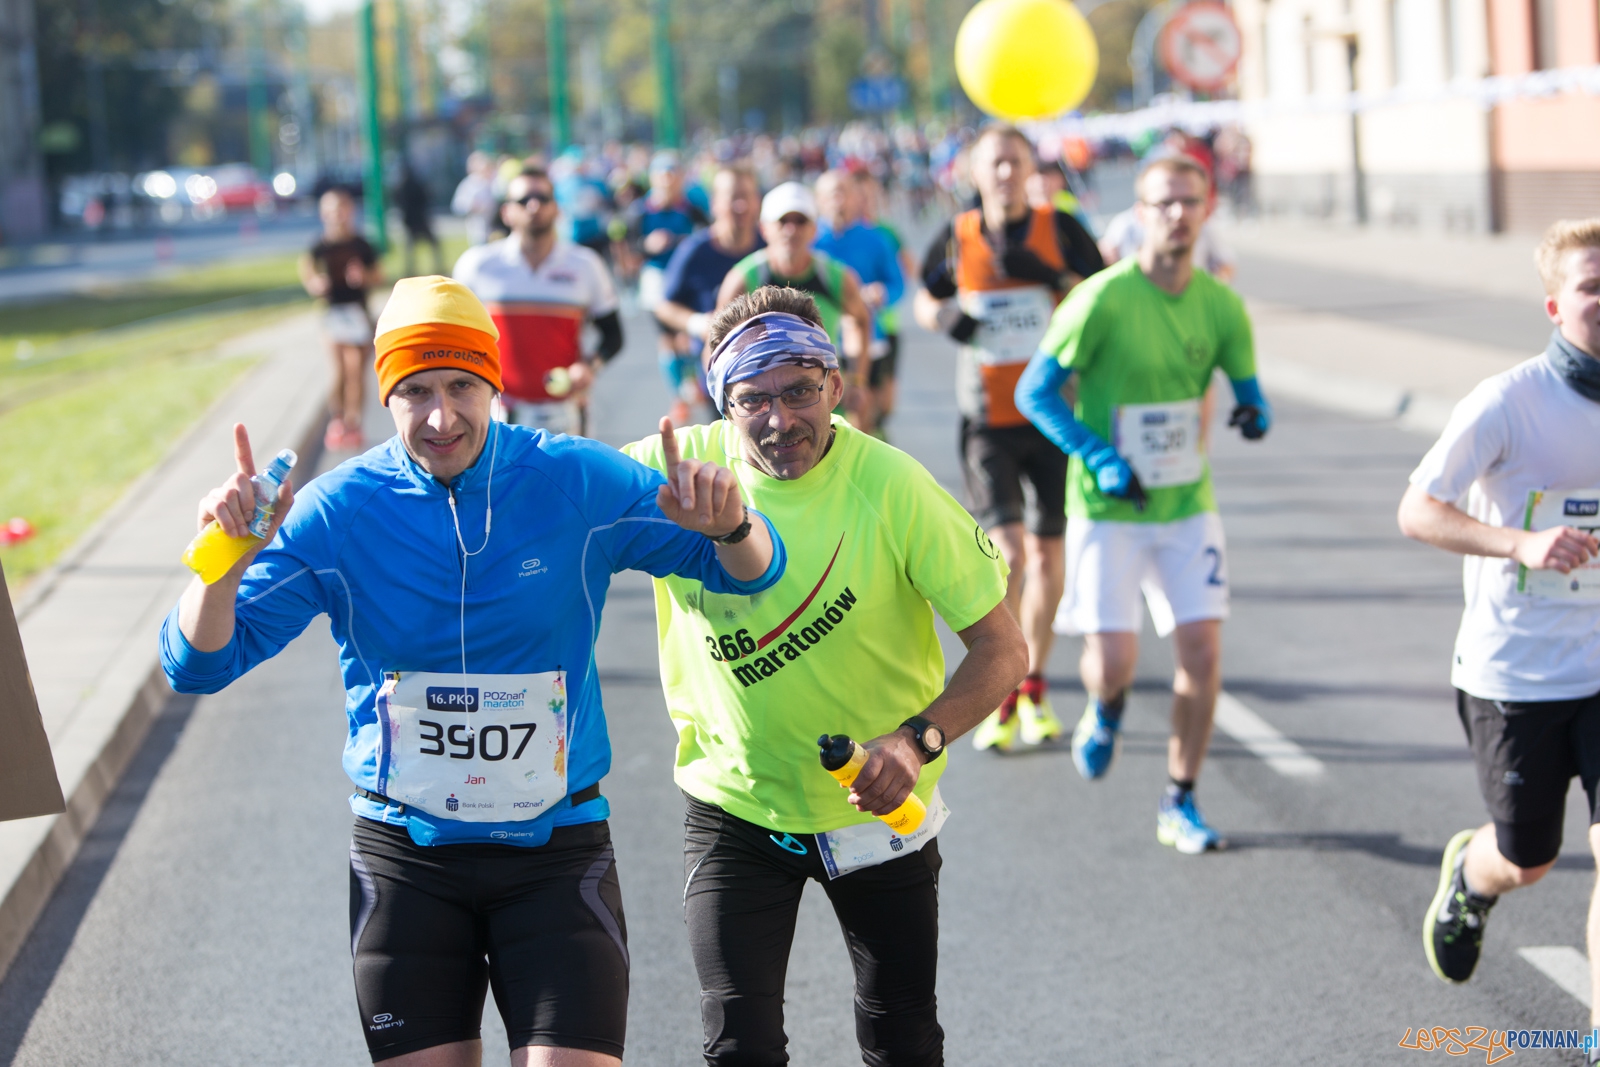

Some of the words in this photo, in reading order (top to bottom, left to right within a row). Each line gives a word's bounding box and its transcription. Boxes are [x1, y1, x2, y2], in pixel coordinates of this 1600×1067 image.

[422, 349, 484, 367] marathon
[518, 566, 548, 578] Kalenji
[1205, 546, 1224, 586] 2
[731, 586, 858, 688] maratonów
[705, 628, 757, 662] 366
[430, 693, 447, 705] 16.
[448, 693, 475, 706] PKO
[483, 699, 525, 708] maraton
[419, 719, 537, 761] 3907
[463, 774, 486, 785] Jan
[370, 1019, 404, 1031] Kalenji
